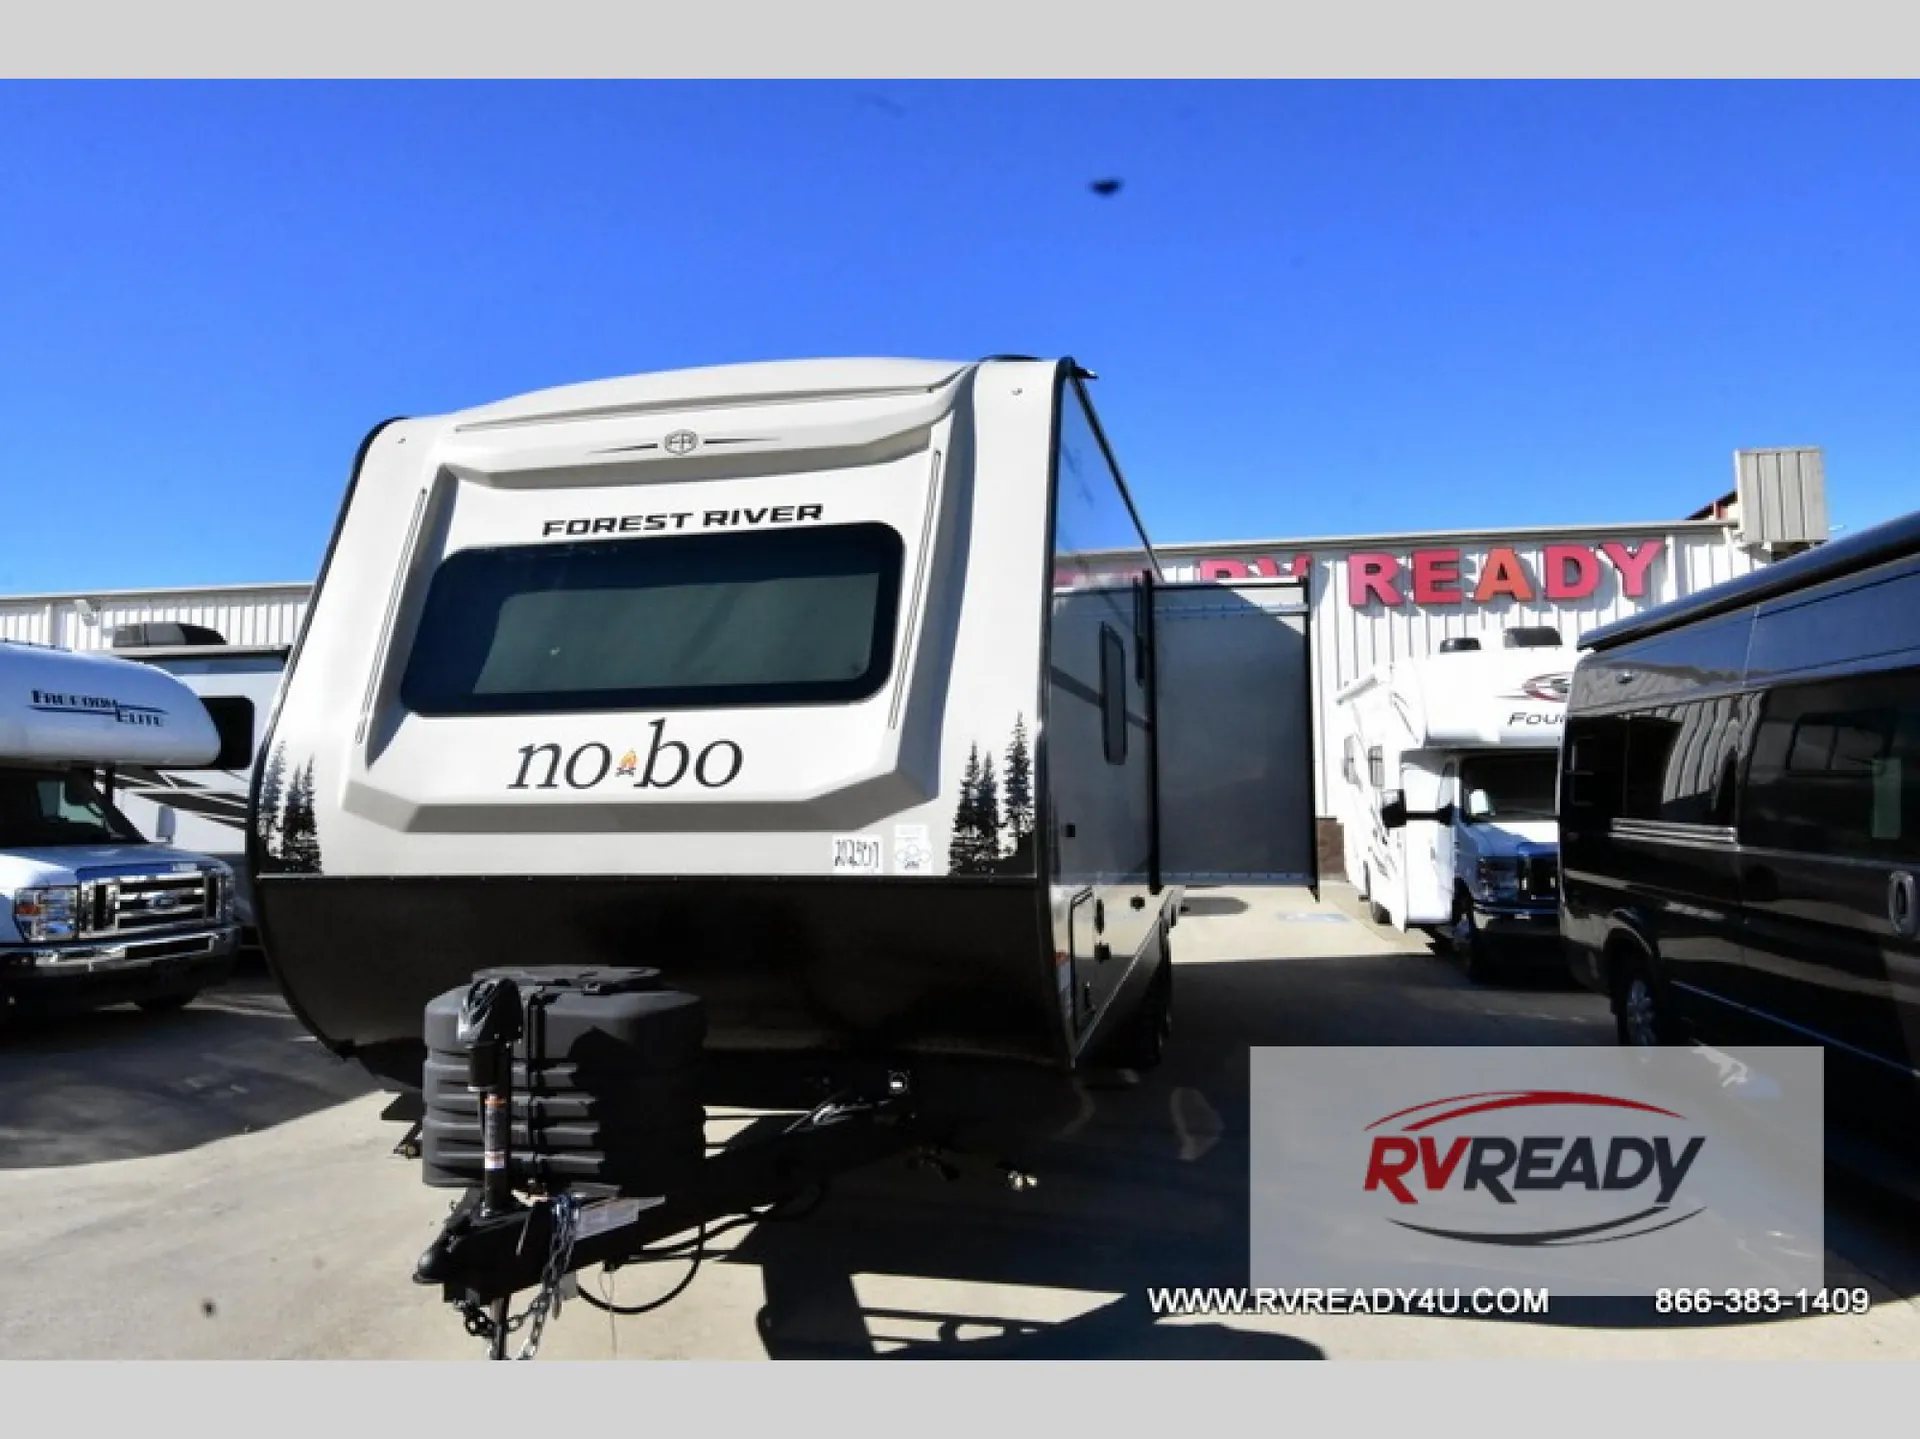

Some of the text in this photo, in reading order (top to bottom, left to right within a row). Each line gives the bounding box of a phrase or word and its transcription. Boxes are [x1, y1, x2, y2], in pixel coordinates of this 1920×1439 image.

[542, 503, 824, 537] FOREST RIVER
[1349, 542, 1662, 607] READY
